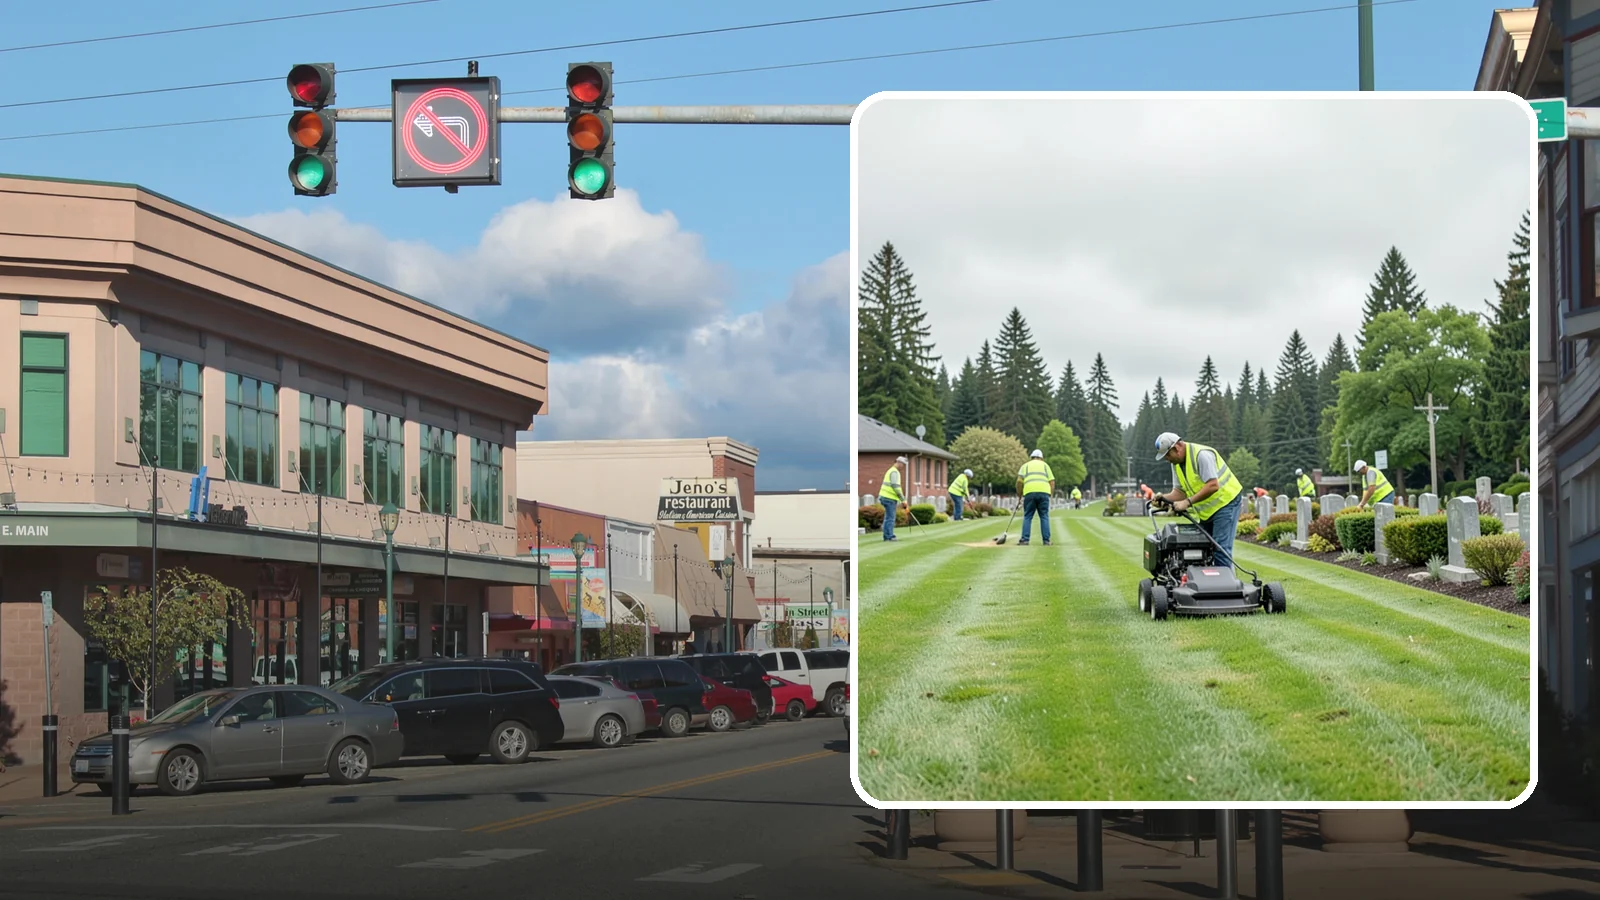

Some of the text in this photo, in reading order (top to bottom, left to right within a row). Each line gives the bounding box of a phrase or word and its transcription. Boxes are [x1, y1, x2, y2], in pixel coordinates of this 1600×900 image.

[670, 480, 727, 494] Jeno's
[665, 497, 731, 509] restaurant
[659, 510, 681, 519] Italian
[686, 510, 714, 519] American
[715, 510, 737, 519] Cuisine
[2, 525, 49, 536] E. MAIN
[797, 608, 828, 616] Street
